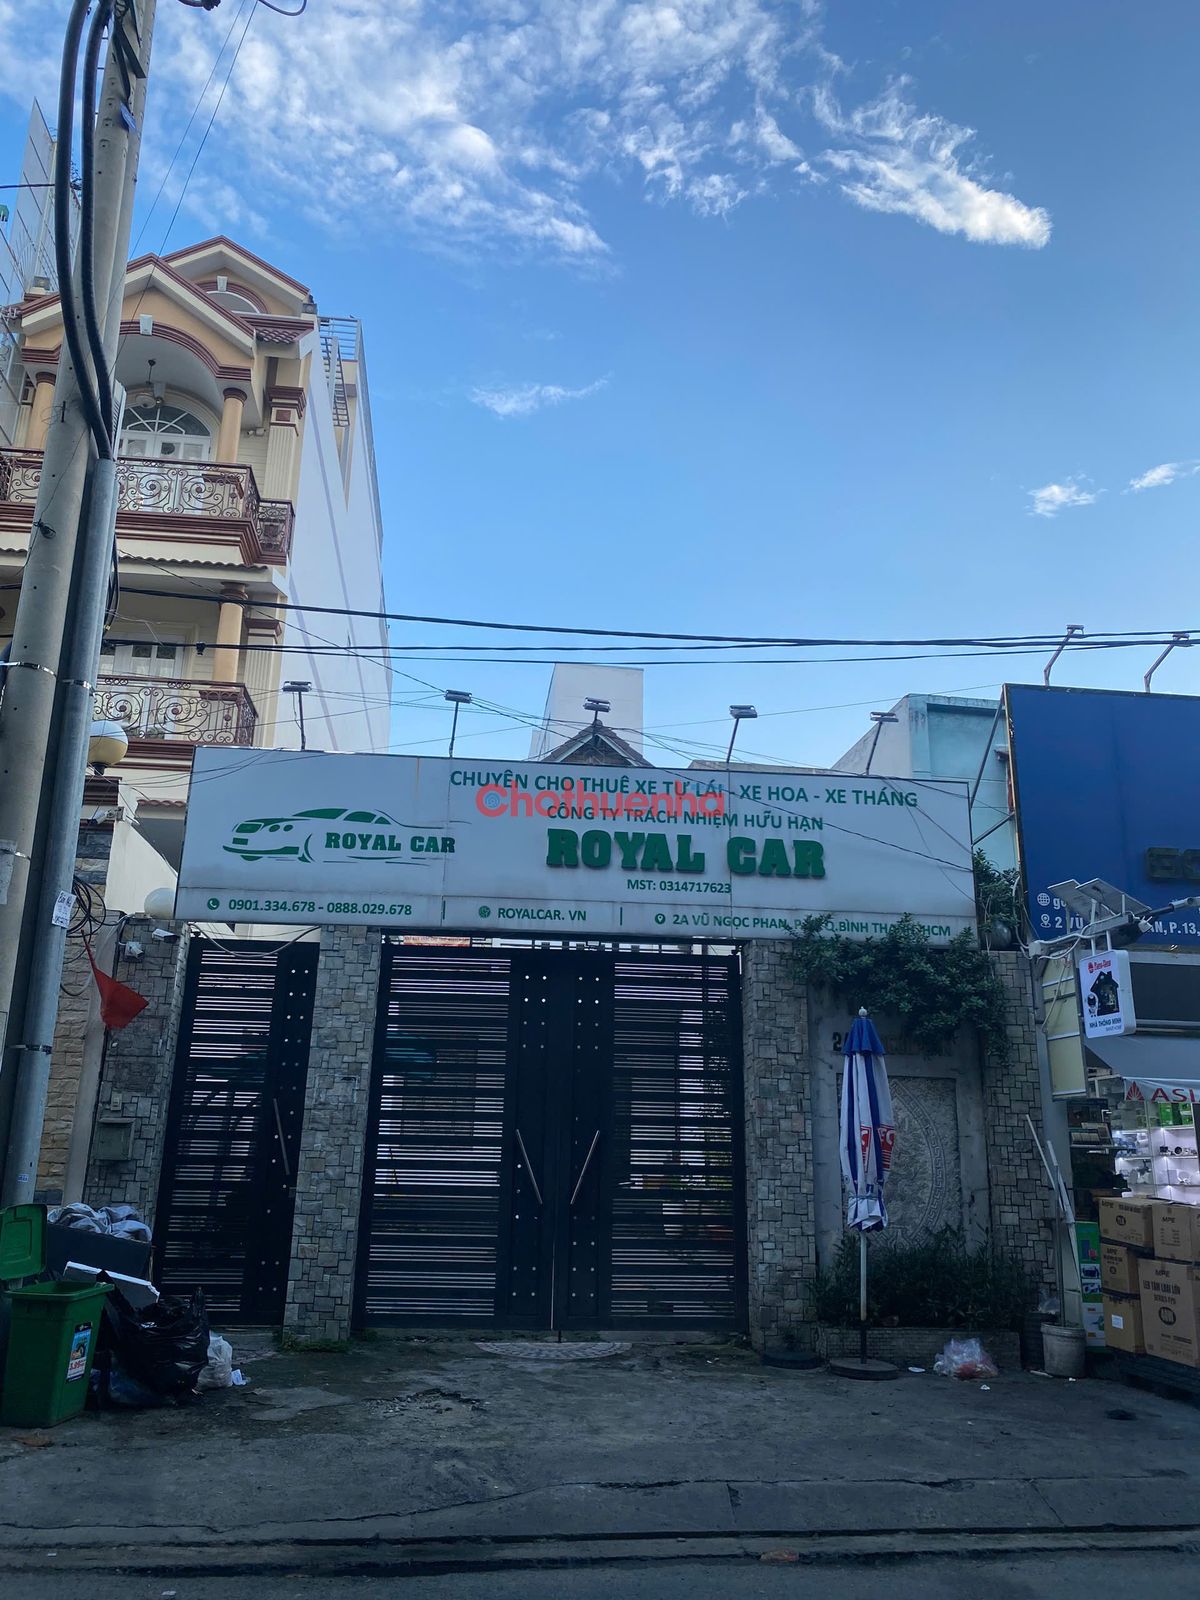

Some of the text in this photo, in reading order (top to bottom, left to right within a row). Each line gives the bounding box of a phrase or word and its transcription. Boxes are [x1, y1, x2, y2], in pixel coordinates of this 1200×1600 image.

[450, 770, 528, 789] CHUYÊN
[535, 775, 575, 791] CHO
[580, 774, 630, 794] THUÊ
[635, 780, 657, 796] XE
[740, 784, 762, 800] XE
[768, 786, 809, 803] HOA
[825, 788, 848, 805] XE
[852, 786, 918, 807] THÁNG
[547, 803, 595, 821] CÔNG
[599, 808, 620, 822] TY
[624, 805, 678, 824] TRÁCH
[744, 810, 782, 829] HỮU
[787, 816, 824, 832] HẠN
[325, 832, 456, 853] ROYAL CAR
[546, 827, 826, 878] ROYAL CAR
[627, 879, 732, 894] MST: 0314717623
[228, 899, 316, 913] 0901.334.678
[327, 902, 412, 916] 0888.029.678
[569, 909, 587, 921] VN
[673, 914, 689, 926] 2A
[692, 912, 710, 927] VŨ
[713, 915, 750, 930] NGỌC
[1151, 1087, 1200, 1103] ASI
